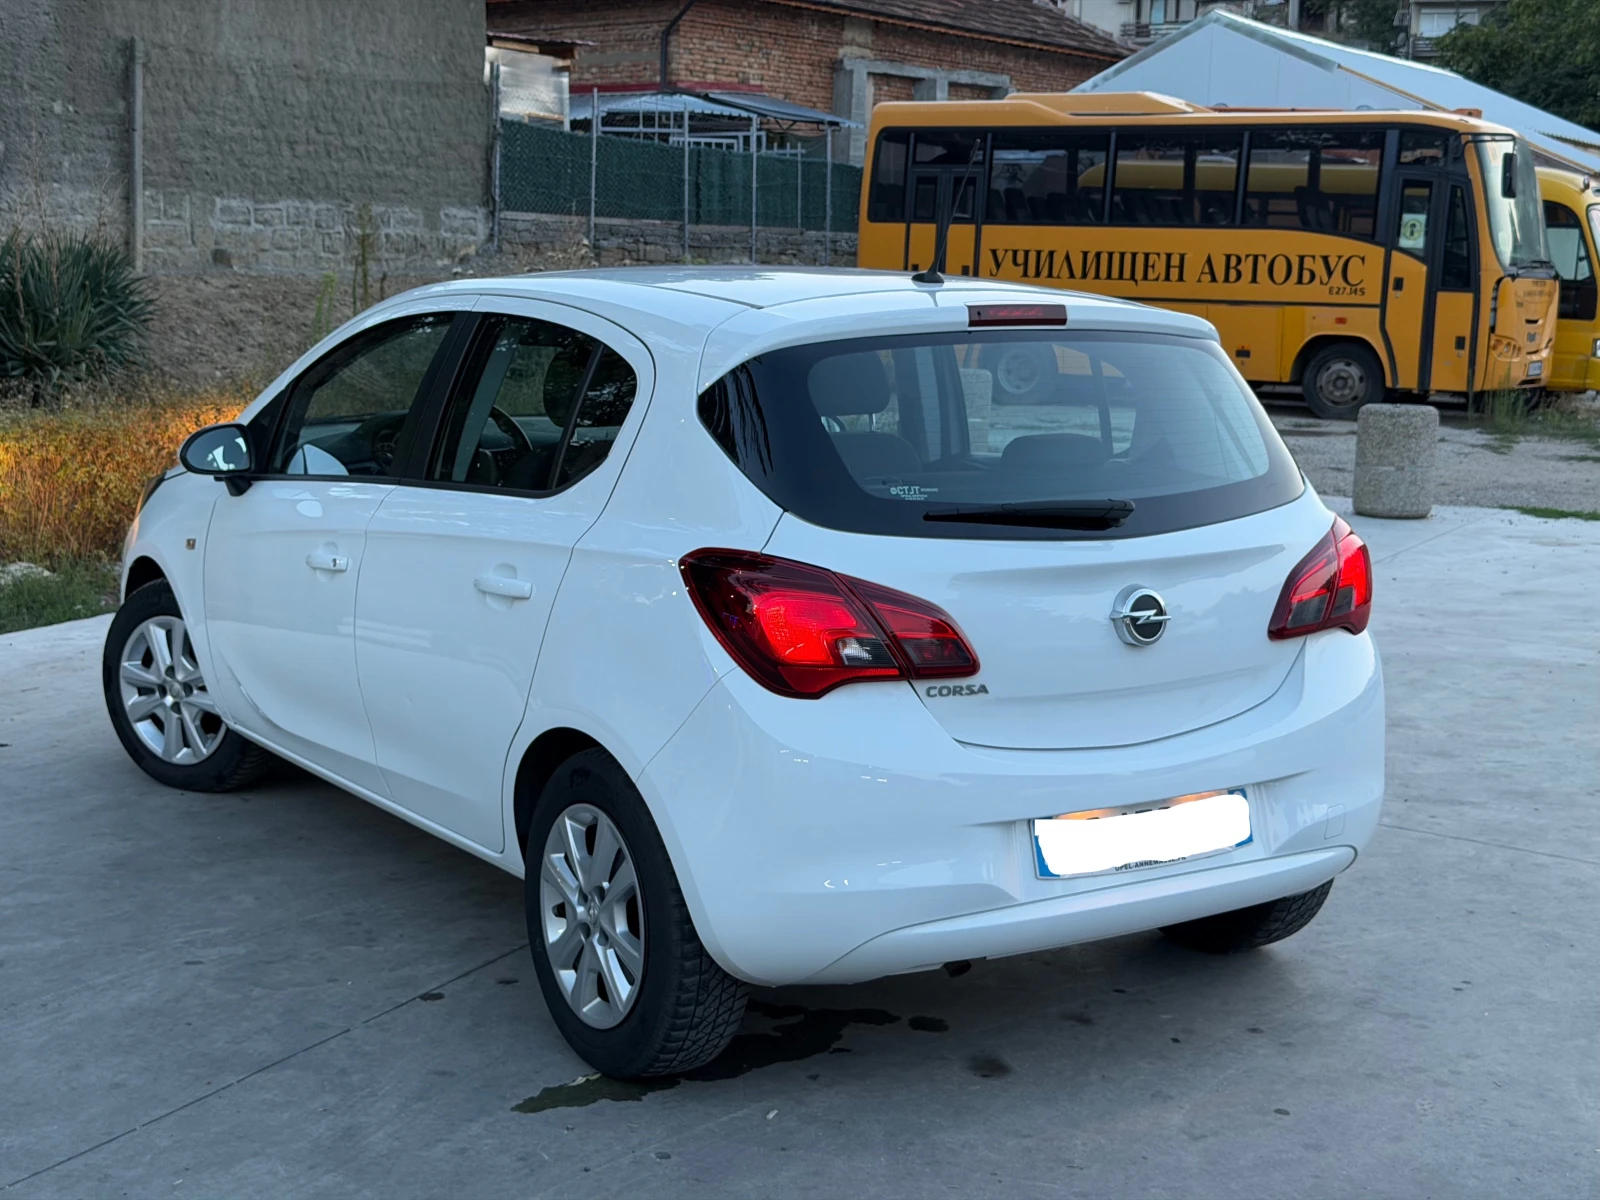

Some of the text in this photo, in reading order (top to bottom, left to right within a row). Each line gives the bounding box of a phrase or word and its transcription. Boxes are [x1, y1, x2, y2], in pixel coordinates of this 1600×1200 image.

[988, 248, 1366, 287] УЧИЛИЩЕН АВТОБУС
[925, 683, 989, 698] CORSA
